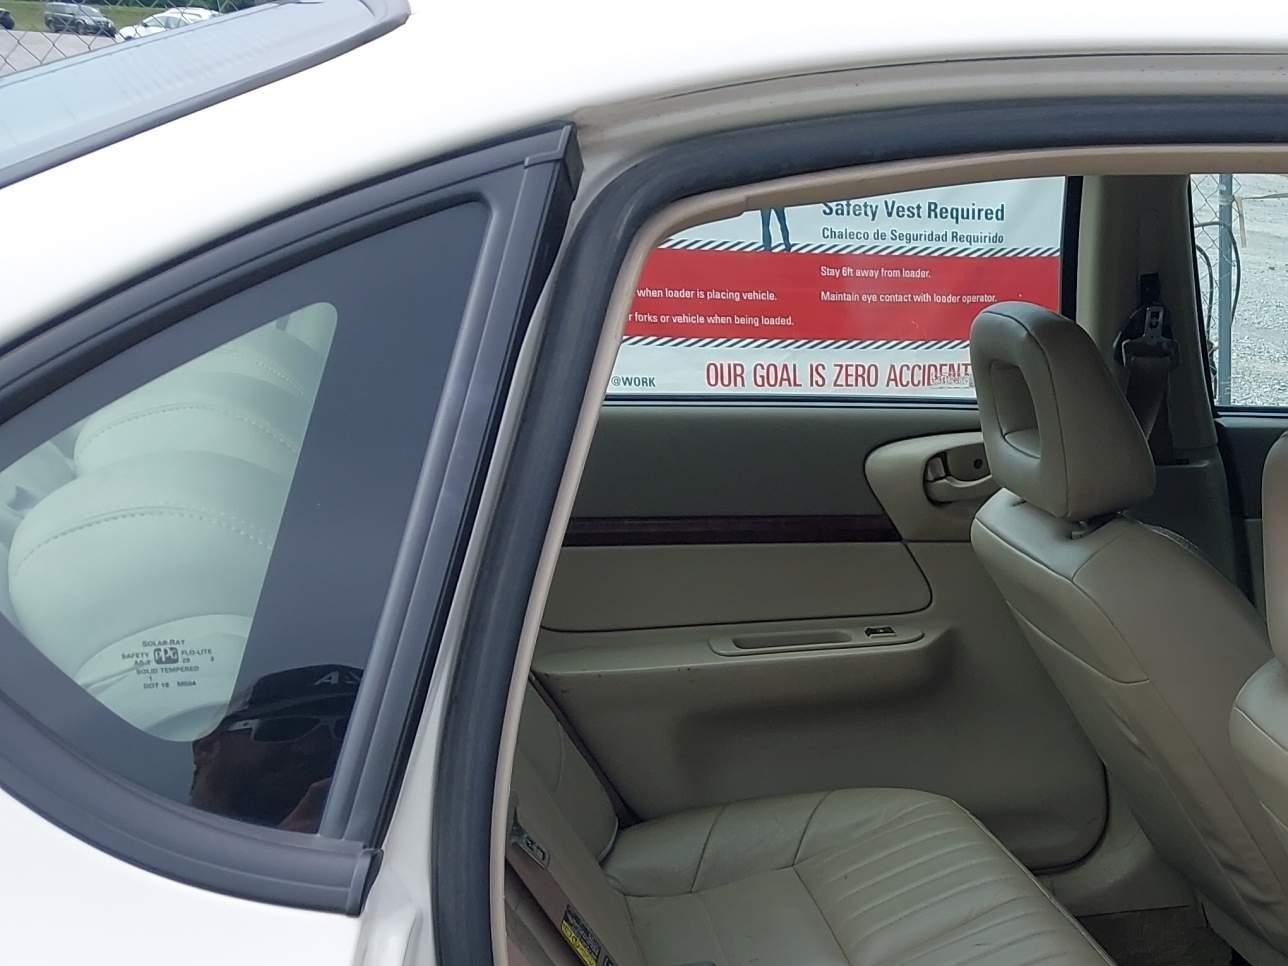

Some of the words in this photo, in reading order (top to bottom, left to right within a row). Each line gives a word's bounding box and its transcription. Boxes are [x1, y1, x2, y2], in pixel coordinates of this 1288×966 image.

[822, 200, 879, 221] Safety
[884, 200, 922, 219] Vest
[927, 201, 1005, 224] Required
[822, 227, 869, 240] Chaleco
[874, 228, 886, 241] de
[890, 229, 948, 244] Seguridad
[951, 231, 1004, 246] Requirido
[820, 266, 840, 278] Stay
[842, 267, 854, 276] 6ft
[856, 269, 879, 278] away
[880, 268, 900, 277] from
[902, 268, 932, 278] loader.
[636, 288, 664, 298] when
[665, 288, 694, 298] loader
[696, 289, 704, 298] is
[706, 289, 740, 302] placing
[742, 290, 778, 300] vehicle.
[820, 291, 860, 301] Maintain
[862, 294, 877, 304] eye
[880, 292, 913, 302] contact
[913, 292, 932, 303] with
[934, 293, 961, 304] loader
[962, 294, 997, 304] operator.
[634, 312, 658, 322] forks
[660, 314, 670, 322] or
[672, 313, 704, 323] vehicle
[706, 314, 732, 324] when
[734, 314, 759, 326] being
[762, 315, 794, 326] loaded.
[706, 362, 745, 388] OUR
[753, 362, 802, 388] GOAL
[809, 363, 826, 388] IS
[833, 363, 878, 388] ZERO
